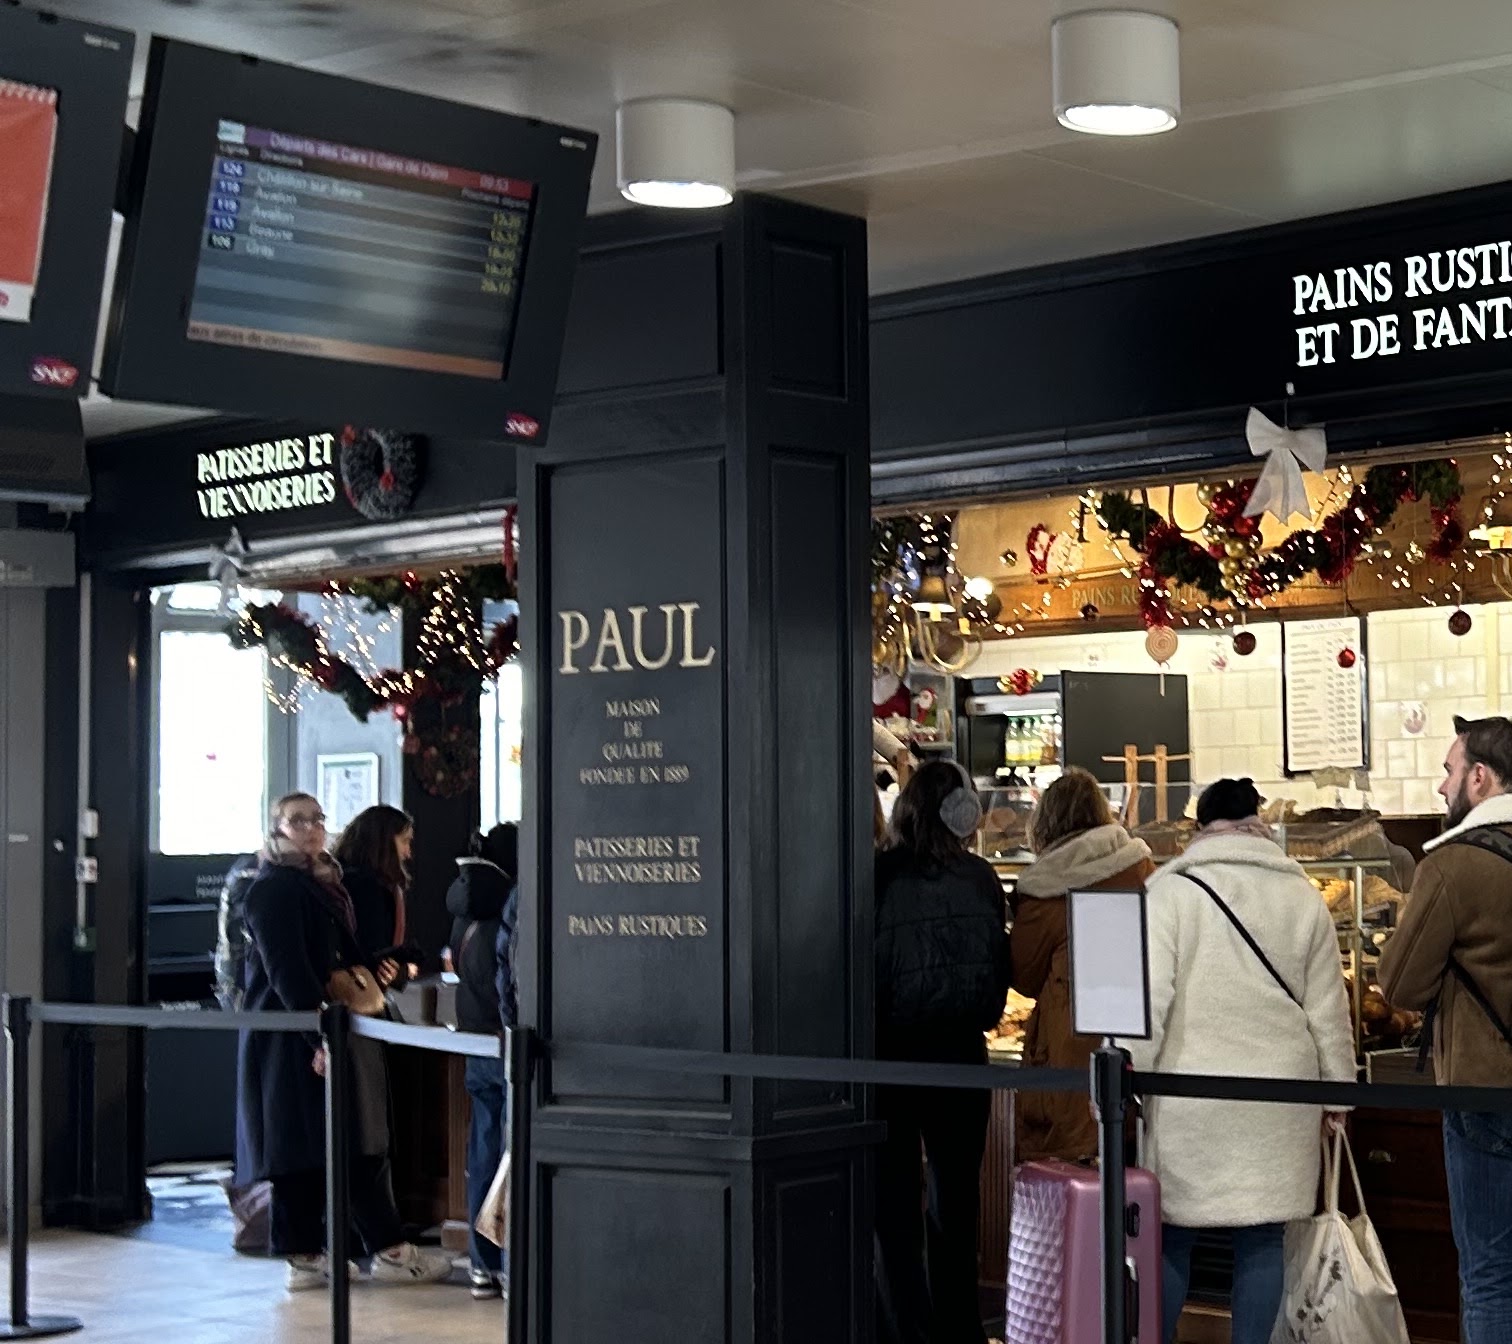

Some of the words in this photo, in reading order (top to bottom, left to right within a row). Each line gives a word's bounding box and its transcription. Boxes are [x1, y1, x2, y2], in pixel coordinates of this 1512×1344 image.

[1292, 262, 1393, 315] PAINS
[1296, 323, 1340, 367] ET
[1350, 314, 1400, 359] DE
[197, 438, 306, 484] PATISSERIES
[308, 432, 335, 467] ET
[197, 470, 336, 519] VIENNOISERIES
[558, 602, 716, 675] PAUL
[606, 696, 660, 717] MAISON
[624, 720, 642, 738] DE
[640, 766, 660, 784] EN
[575, 836, 673, 858] PATISSERIES
[678, 836, 700, 857] ET
[575, 862, 701, 883] VIENNOISERIES
[568, 915, 614, 936] PAINS
[619, 915, 707, 939] RUSTIQUES
